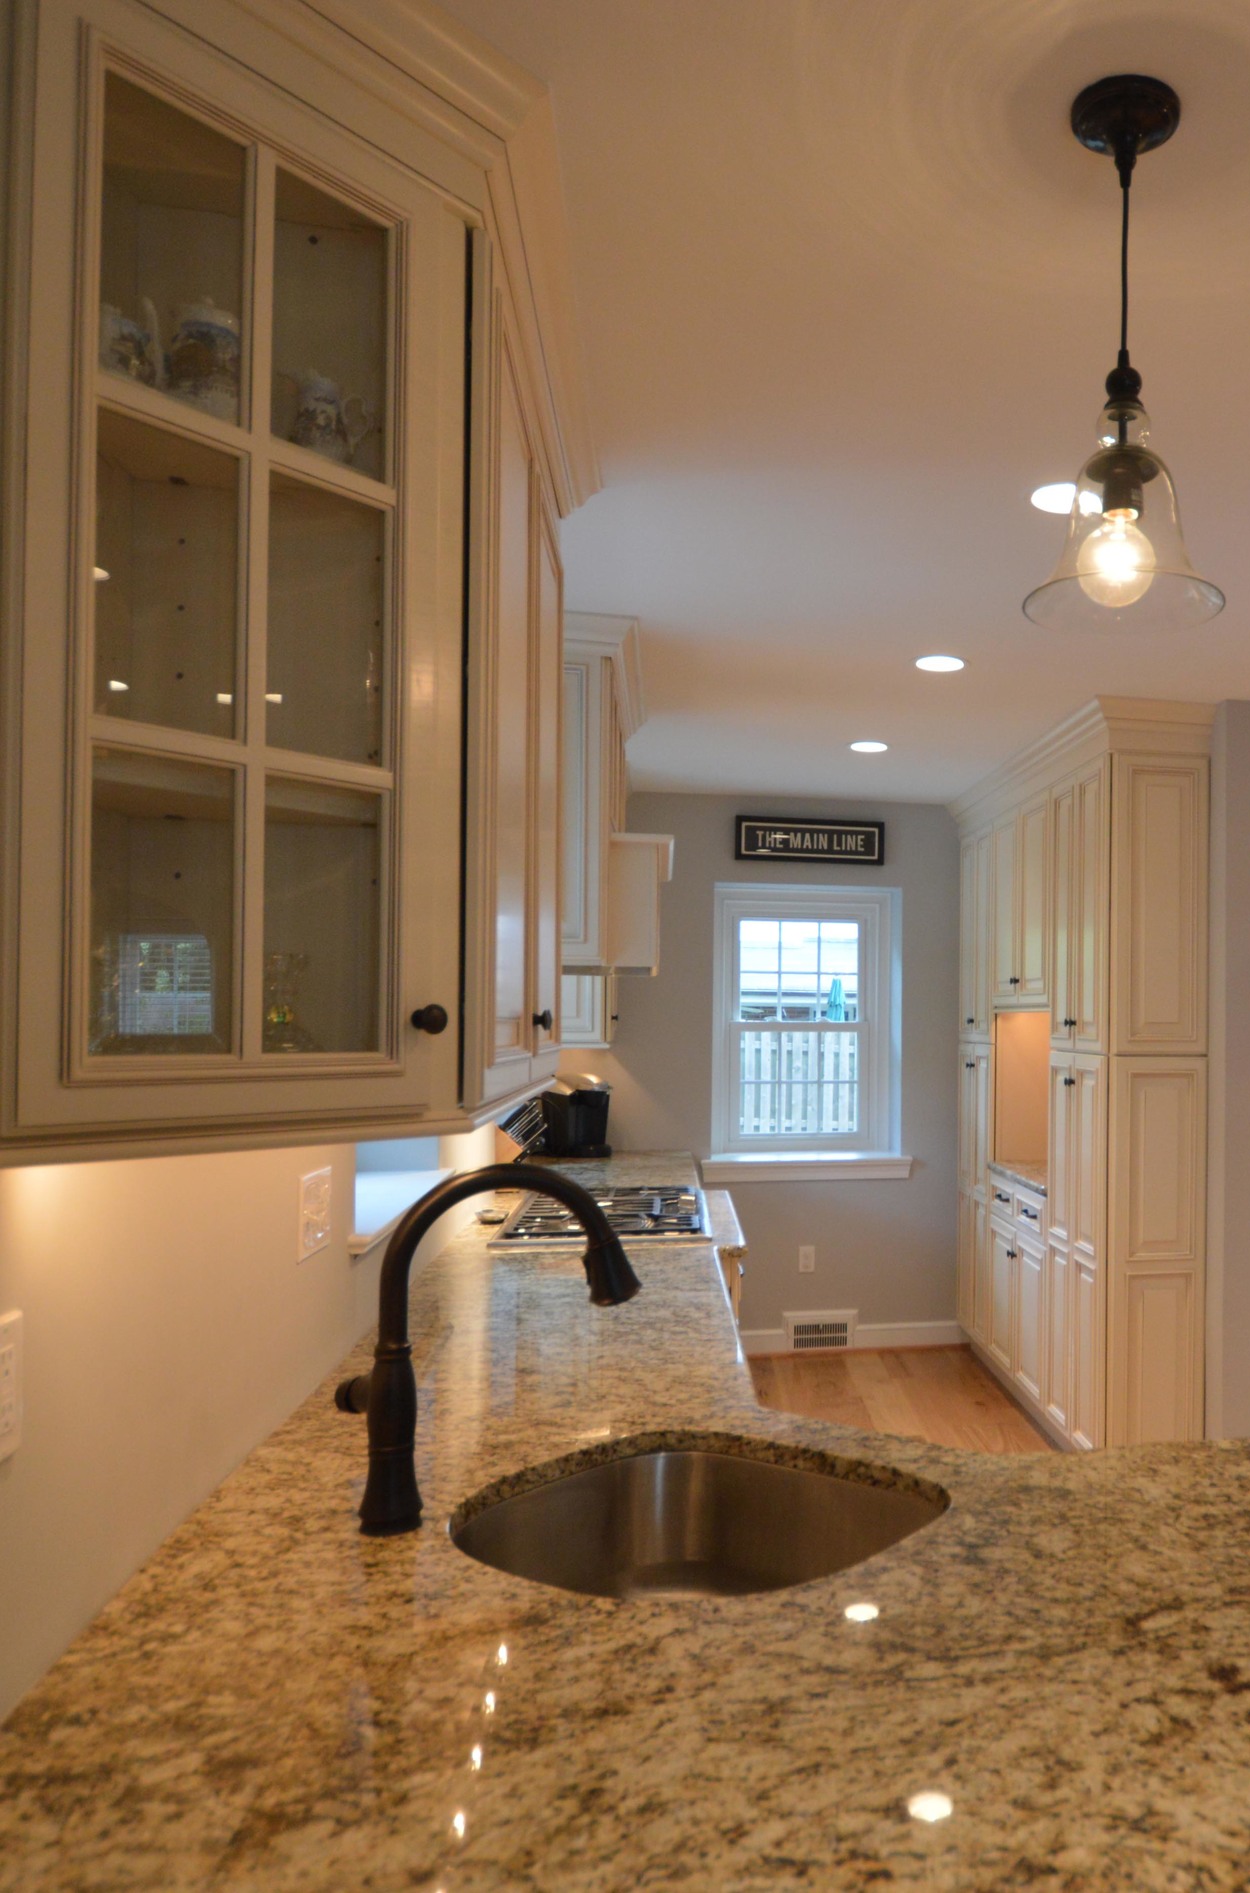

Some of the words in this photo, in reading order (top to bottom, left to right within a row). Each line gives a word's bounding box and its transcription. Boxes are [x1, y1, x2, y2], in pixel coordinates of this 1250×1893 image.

[756, 831, 783, 848] THE
[789, 832, 828, 850] MAIN
[833, 834, 865, 851] LINE
